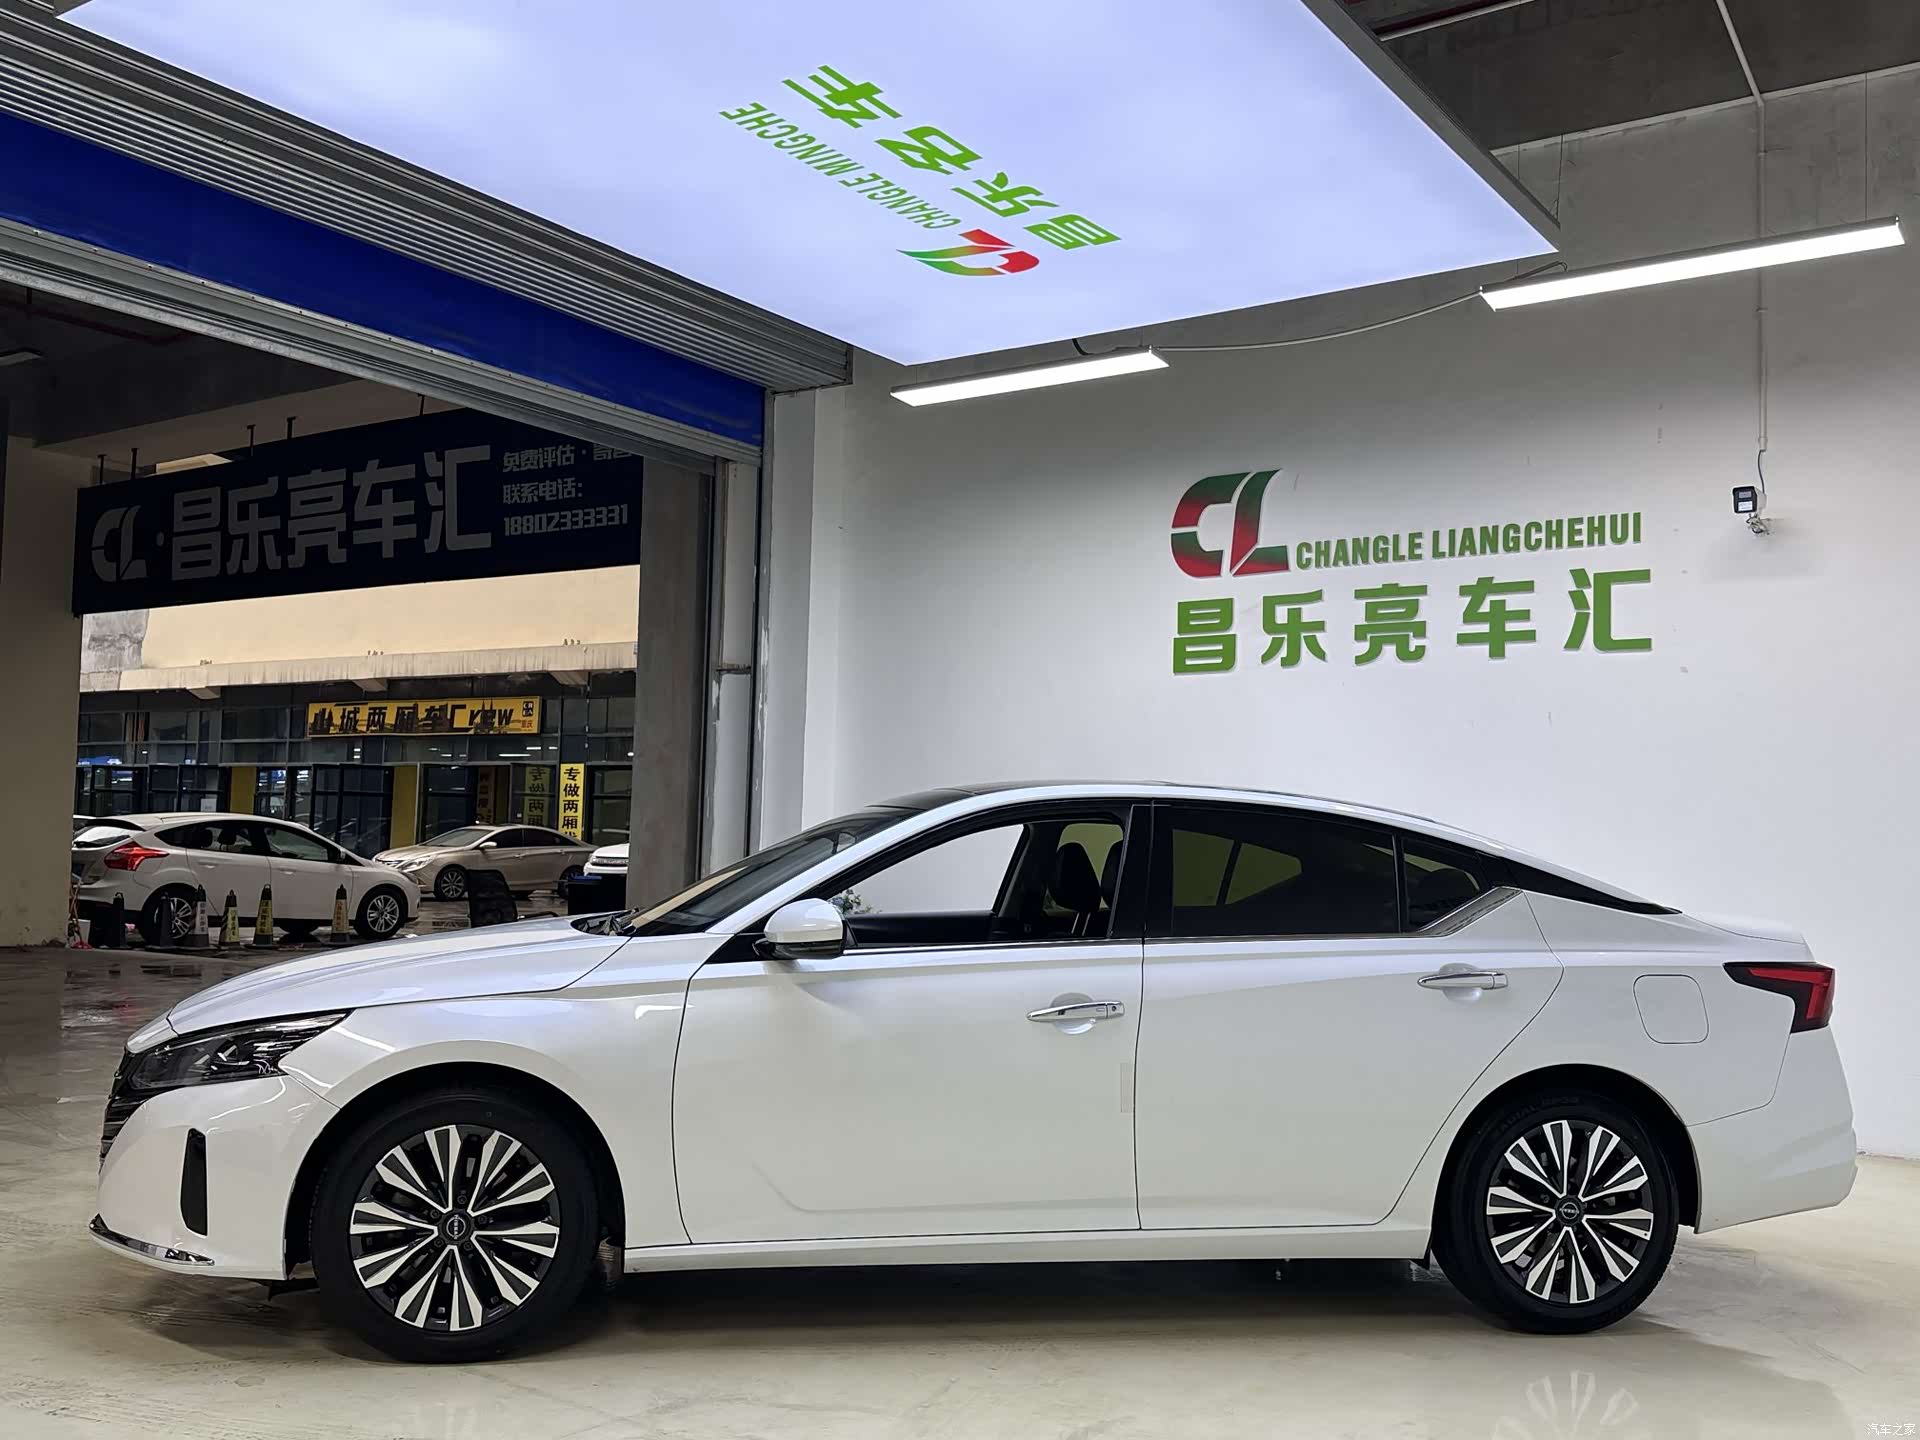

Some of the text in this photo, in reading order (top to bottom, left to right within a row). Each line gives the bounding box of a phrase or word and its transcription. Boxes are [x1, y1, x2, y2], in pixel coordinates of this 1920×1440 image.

[719, 102, 962, 230] CHANGLE MINGCHE
[781, 65, 1121, 250] 昌乐名车
[171, 444, 492, 581] 昌乐亮车汇
[503, 504, 629, 536] 18802333331
[1296, 532, 1423, 570] CHANGLE
[1432, 512, 1642, 560] LIANGCHEHUI
[1173, 568, 1652, 676] 昌乐亮车汇
